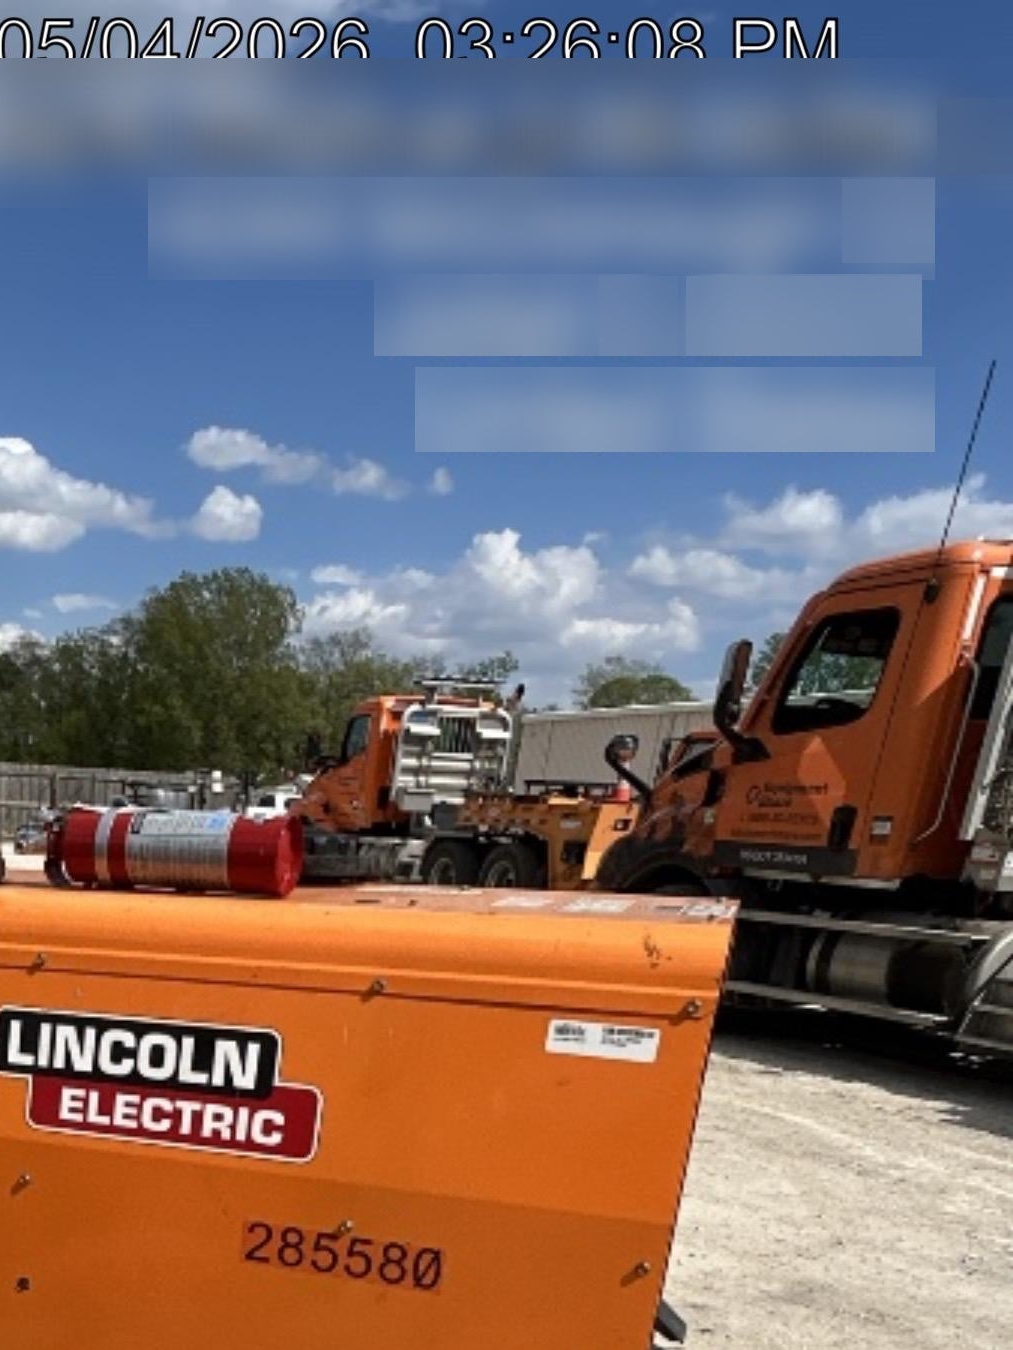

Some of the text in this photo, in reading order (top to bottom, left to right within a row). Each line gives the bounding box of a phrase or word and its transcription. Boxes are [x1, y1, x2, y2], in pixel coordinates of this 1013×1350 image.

[5, 1018, 261, 1091] LINCOLN
[58, 1086, 285, 1146] ELECTRIC
[244, 1221, 443, 1291] 285580
